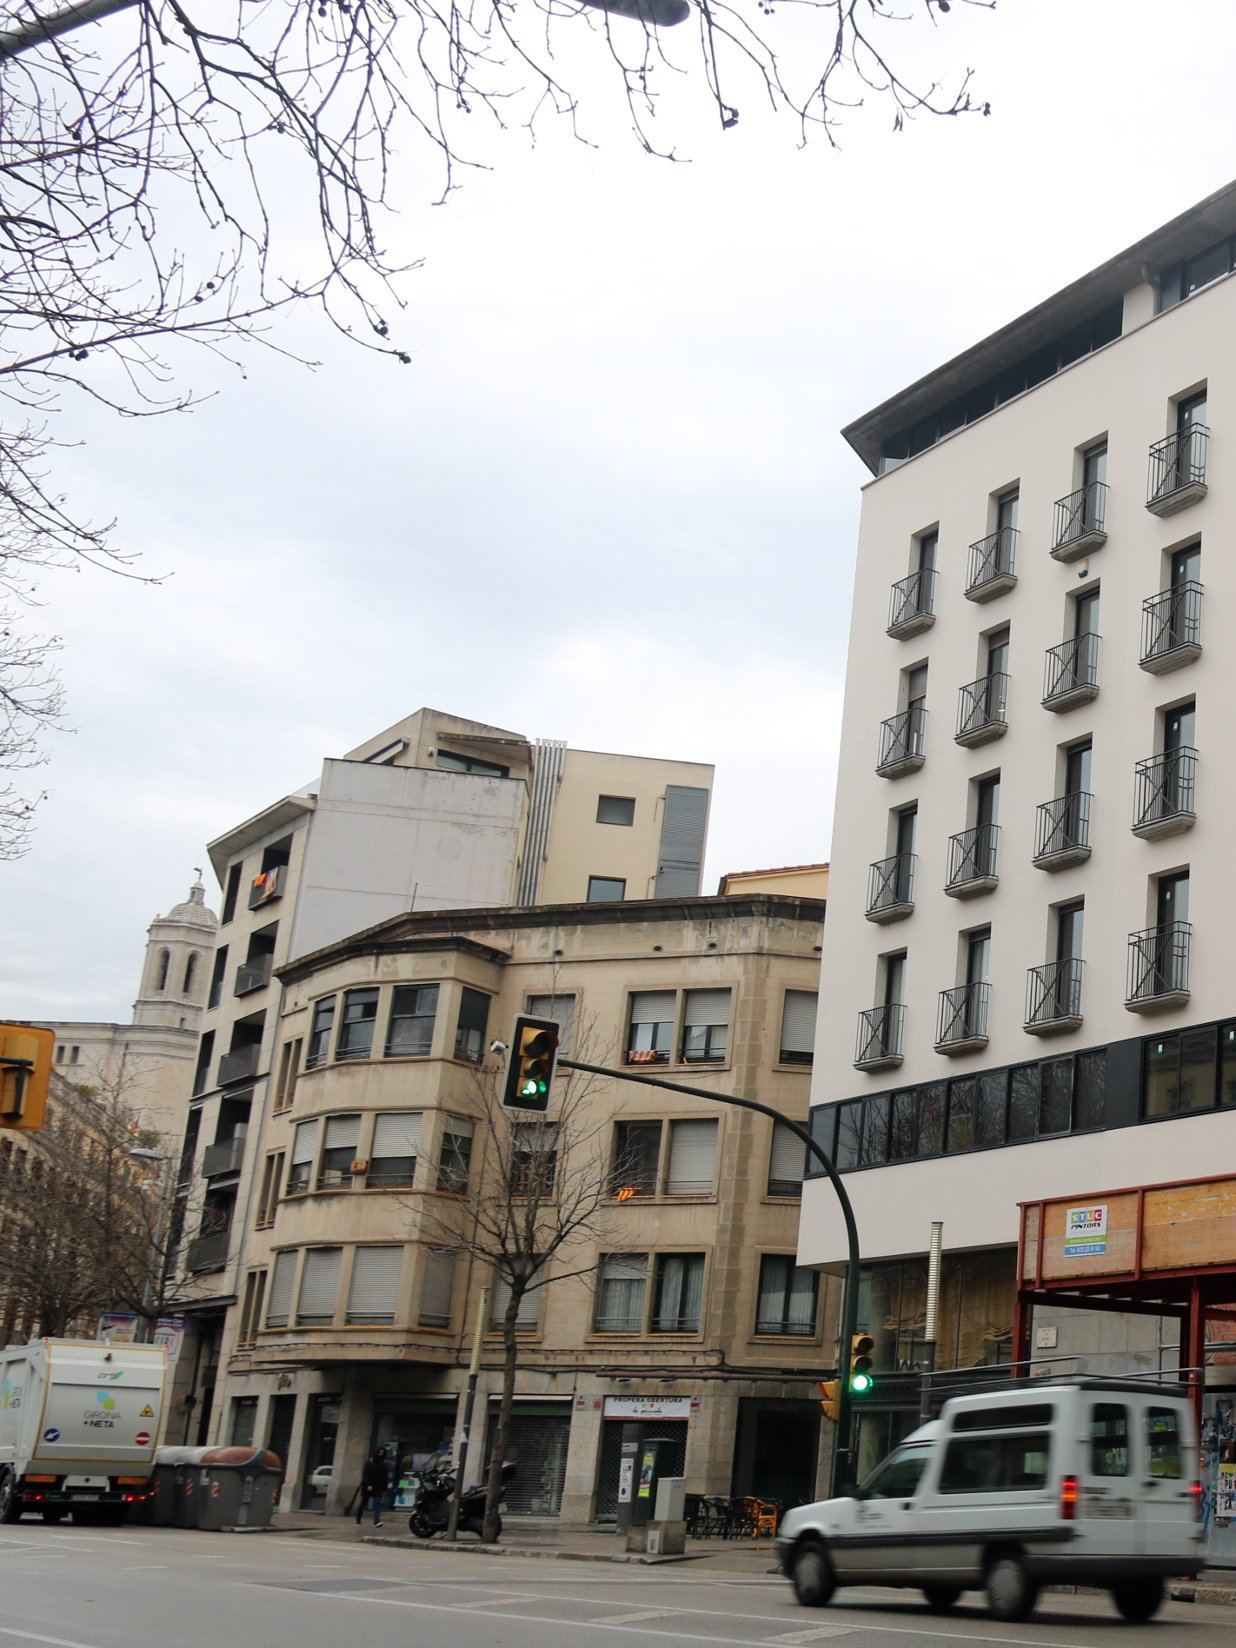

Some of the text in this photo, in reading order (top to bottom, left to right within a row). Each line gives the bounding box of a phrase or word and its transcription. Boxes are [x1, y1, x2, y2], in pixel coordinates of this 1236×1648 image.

[1071, 1210, 1102, 1223] STUC
[1071, 1222, 1102, 1230] PINTORS
[84, 1410, 121, 1419] GIRONA
[83, 1420, 114, 1428] +NETA
